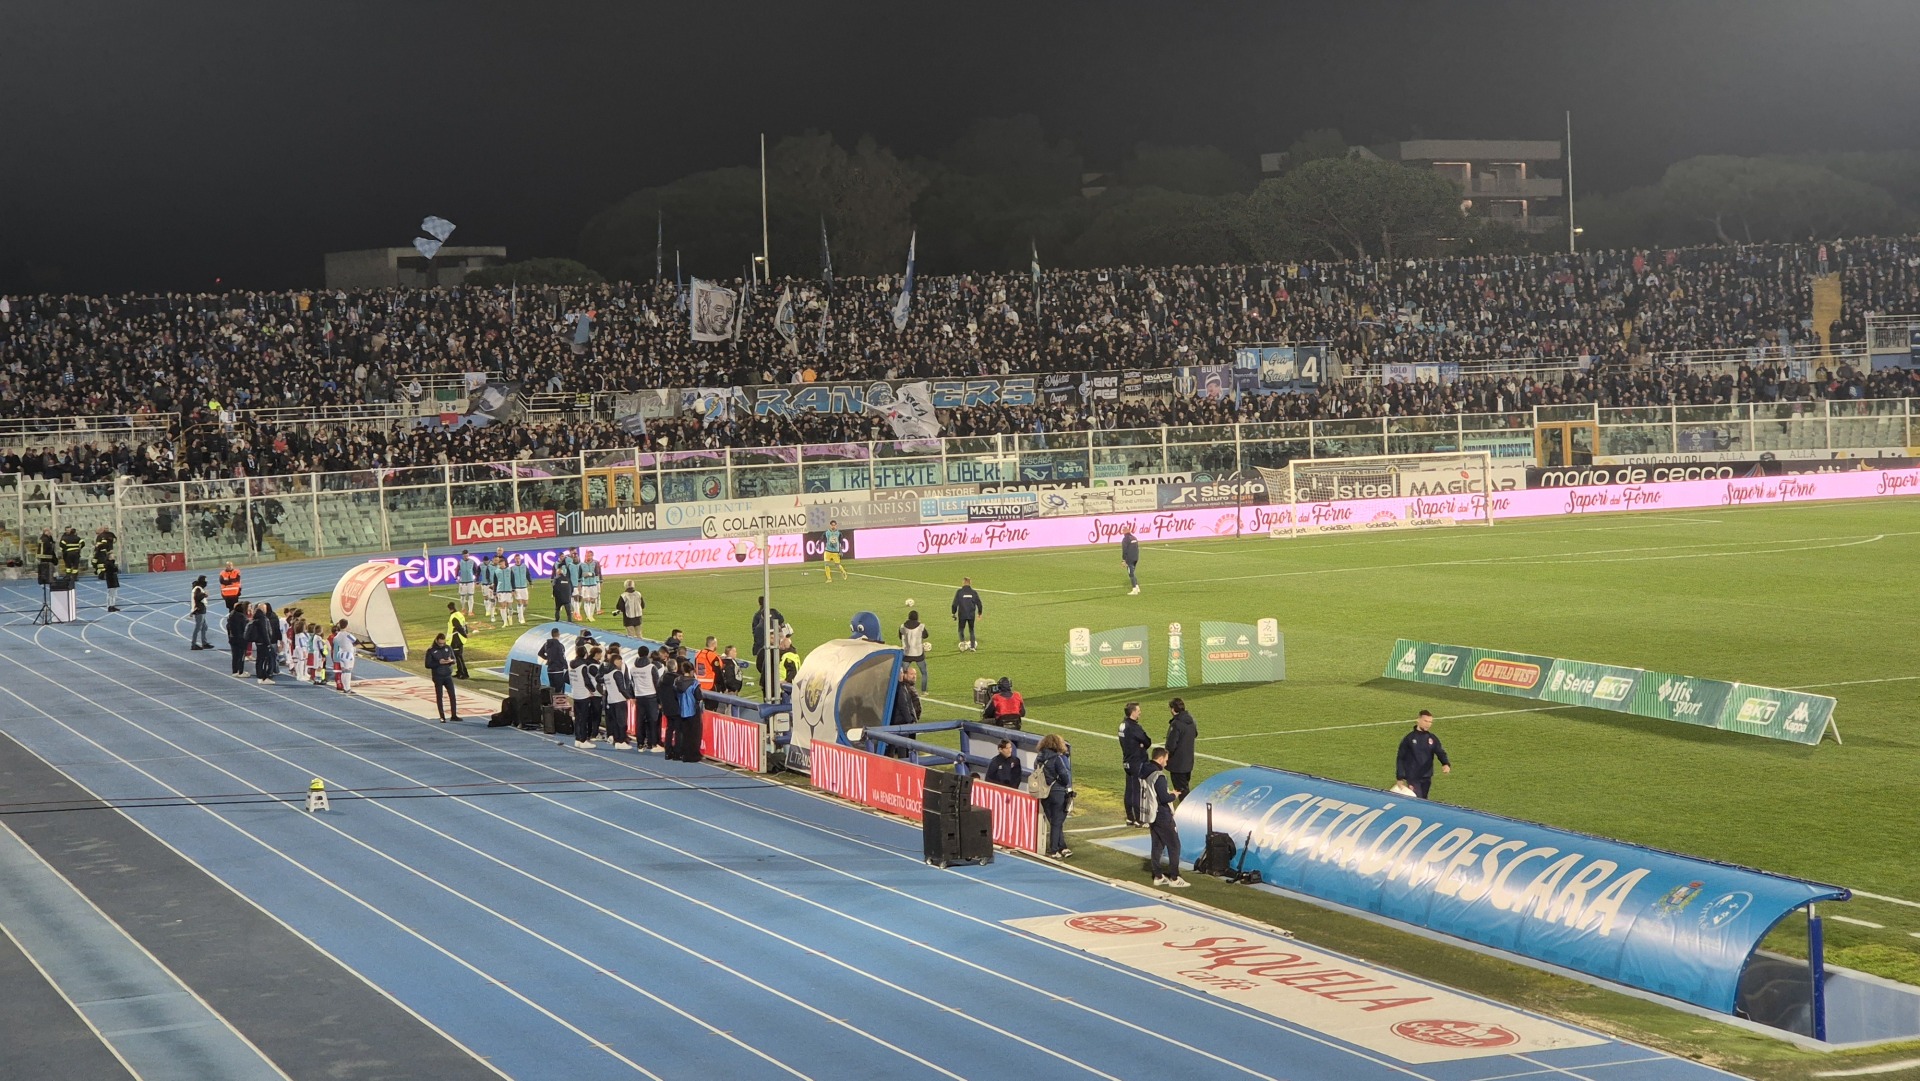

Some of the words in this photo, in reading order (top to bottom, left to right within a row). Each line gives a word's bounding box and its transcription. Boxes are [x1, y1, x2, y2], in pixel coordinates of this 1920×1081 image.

[1302, 356, 1320, 382] 4
[1541, 470, 1609, 488] mario
[1615, 466, 1648, 485] de
[1653, 466, 1734, 483] cecco
[1876, 472, 1919, 495] Sapori
[1564, 489, 1608, 514] Sapori
[1623, 486, 1662, 510] Forno
[1722, 482, 1764, 505] Sapori
[1779, 478, 1817, 503] Forno
[581, 507, 655, 534] Immobiliare
[830, 504, 863, 518] D&M
[868, 501, 917, 515] INFISSI
[969, 505, 1021, 515] MASTINO
[1312, 502, 1353, 525] Forno
[456, 515, 542, 540] LACERBA
[723, 513, 807, 532] COLATRIANO
[1153, 513, 1196, 538] Forno
[917, 527, 968, 553] Sapori
[985, 522, 1030, 548] Forno
[616, 543, 721, 570] ristorazione
[1425, 655, 1455, 674] BKT
[1477, 663, 1494, 678] OLD
[1493, 665, 1514, 680] WILD
[1512, 668, 1537, 683] WEST
[1563, 673, 1594, 693] Serie
[1596, 679, 1631, 698] BKT
[1672, 700, 1702, 716] sport
[1738, 700, 1778, 722] BKT
[1783, 719, 1806, 733] Kappa
[713, 716, 758, 769] VINIDIVINI
[811, 742, 867, 802] VINIDIVINI
[872, 789, 880, 801] VIA
[905, 798, 922, 813] CROCE
[1257, 792, 1400, 867] CITTÀ
[1357, 815, 1442, 882] DI
[1435, 827, 1650, 936] PESCARA
[1162, 936, 1434, 1012] SAQUELLA
[1176, 970, 1260, 991] caffè
